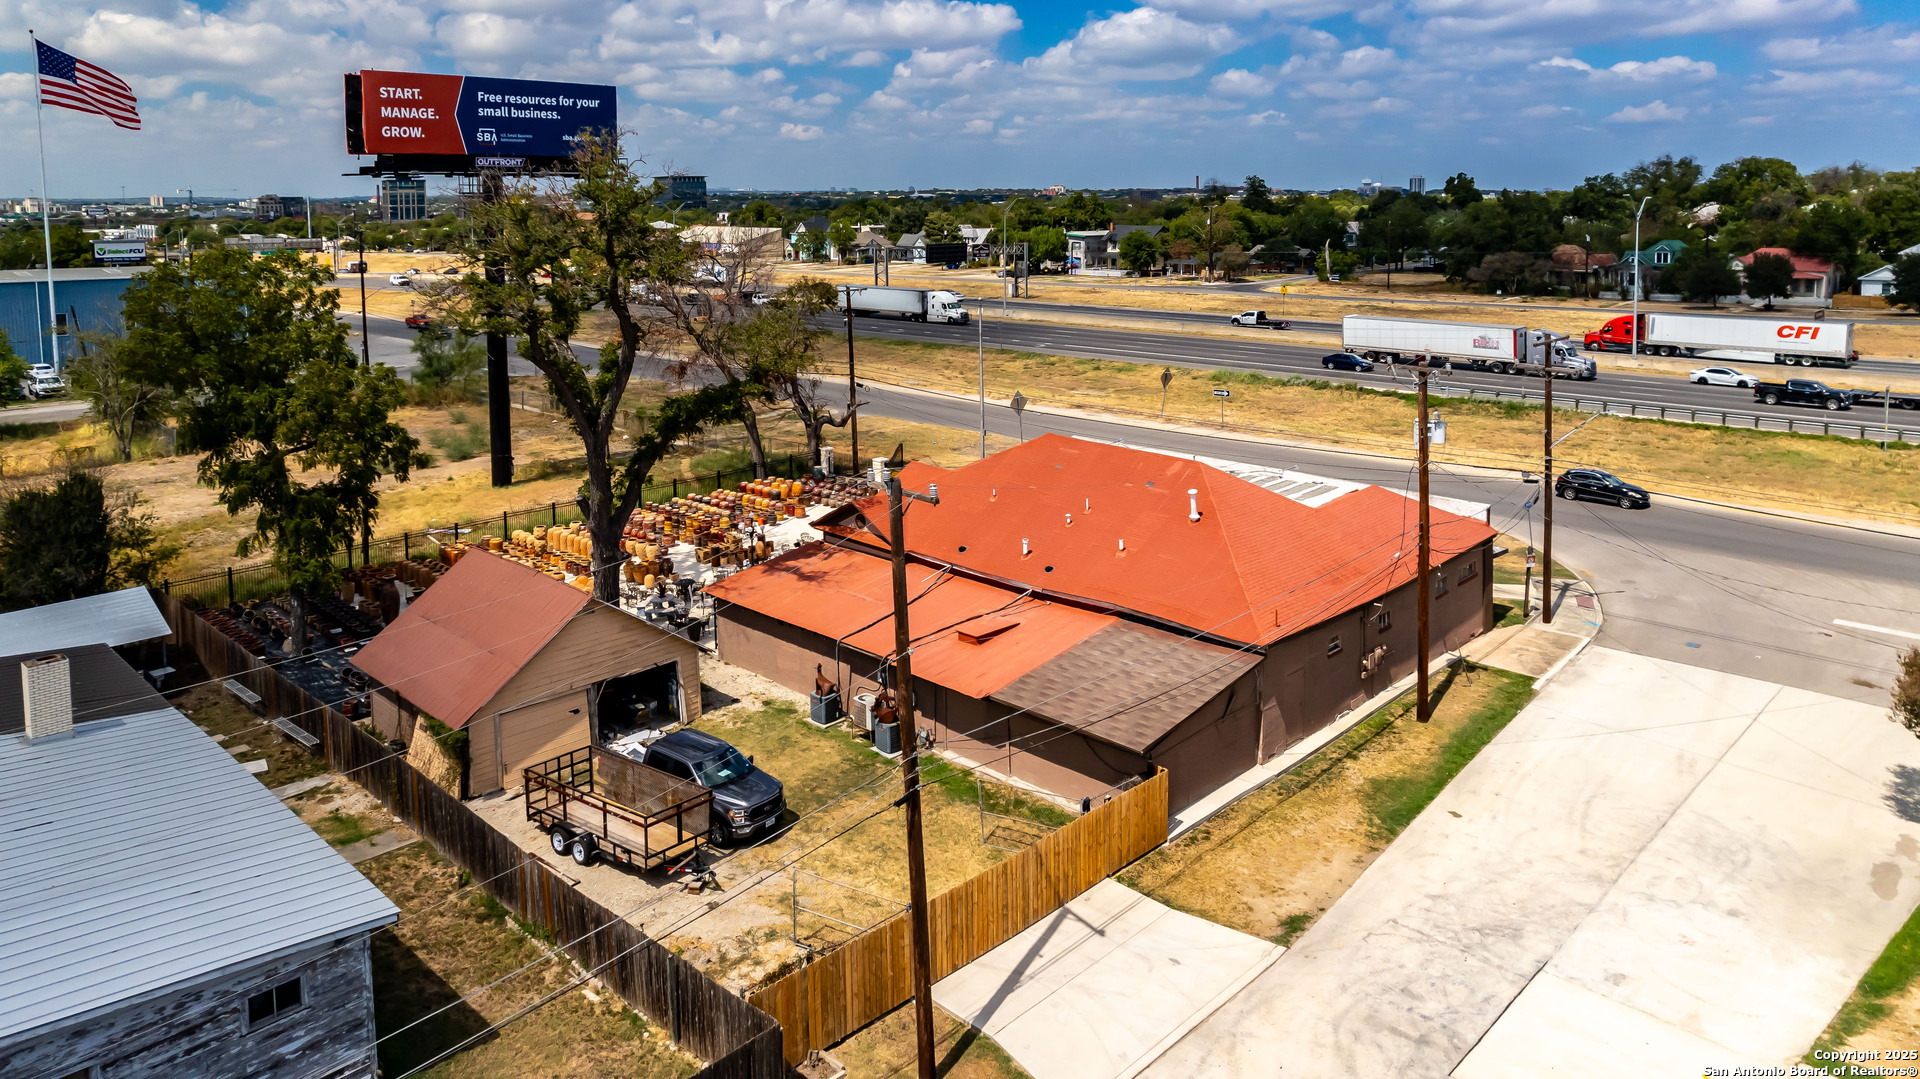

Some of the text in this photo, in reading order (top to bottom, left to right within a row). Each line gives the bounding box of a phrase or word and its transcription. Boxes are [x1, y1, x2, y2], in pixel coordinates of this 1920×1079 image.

[379, 86, 423, 100] START.
[477, 91, 600, 109] Free resources for your
[381, 106, 440, 119] MANAGE.
[478, 106, 561, 119] small business.
[381, 126, 426, 138] GROW.
[476, 132, 498, 145] SBA
[477, 158, 523, 166] OUTFRONT
[1776, 324, 1821, 340] CFI
